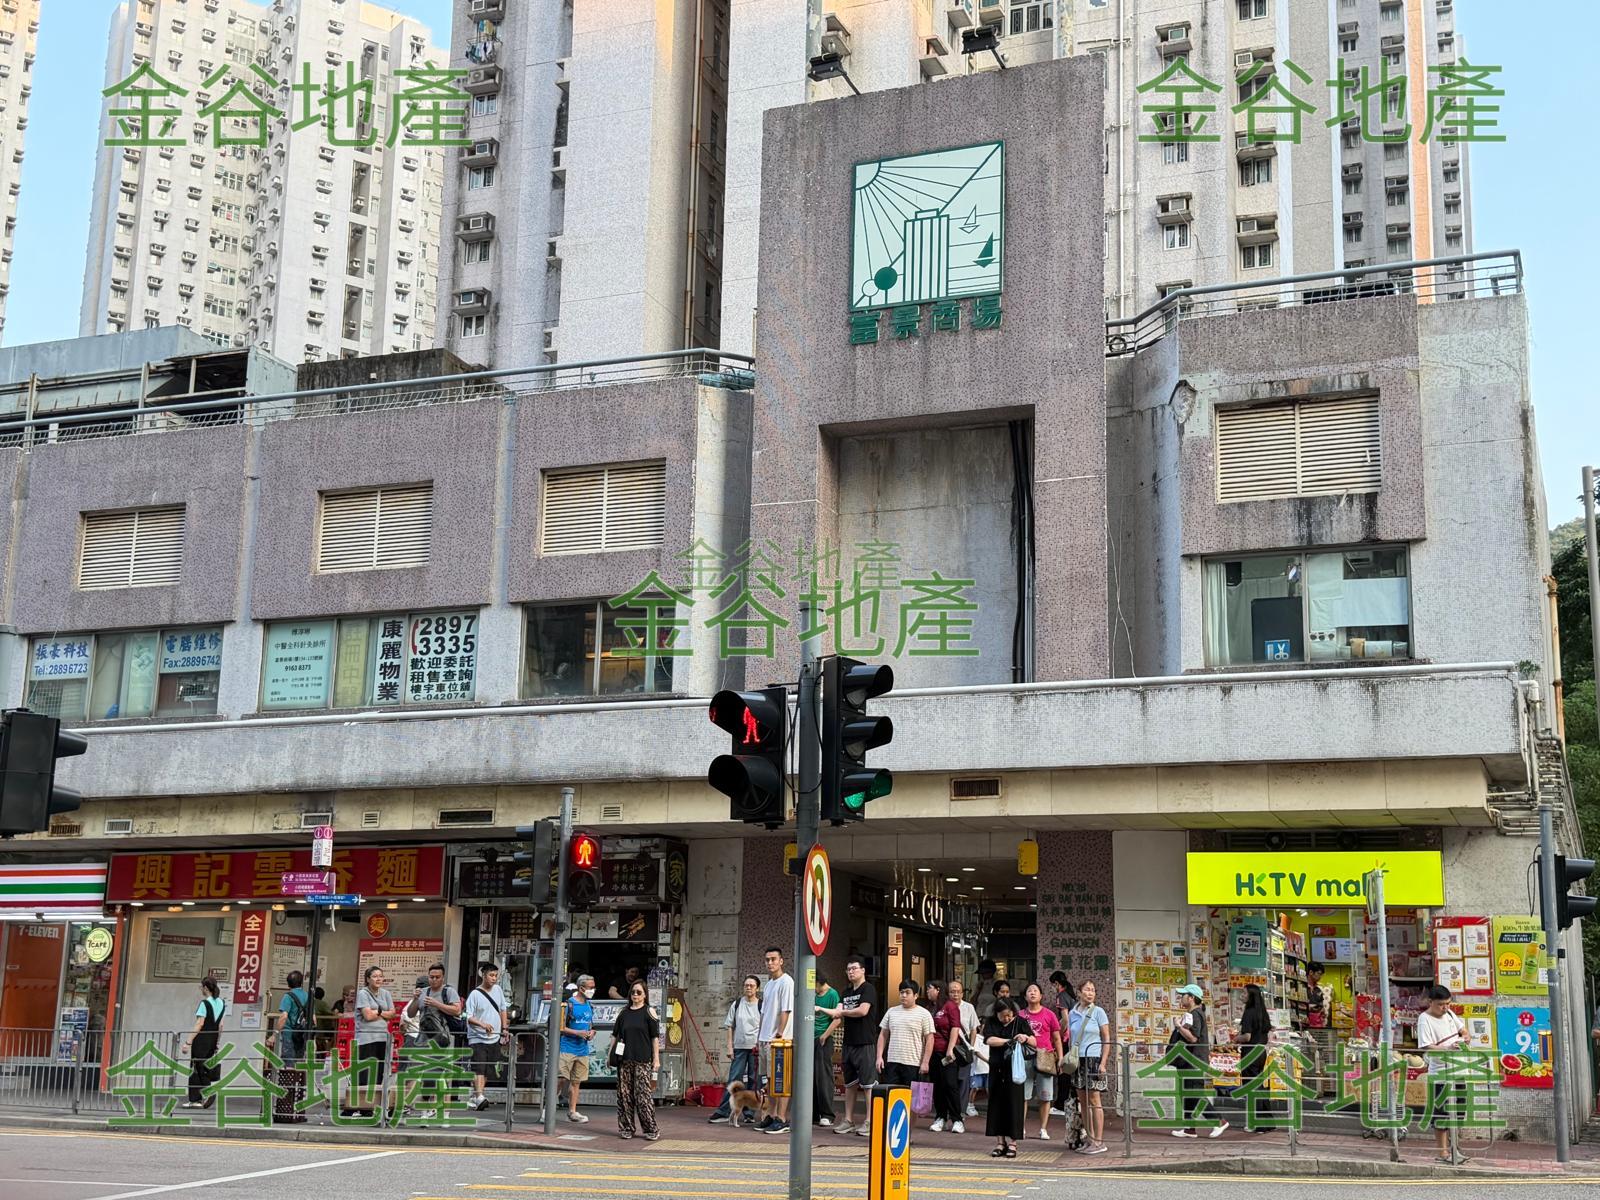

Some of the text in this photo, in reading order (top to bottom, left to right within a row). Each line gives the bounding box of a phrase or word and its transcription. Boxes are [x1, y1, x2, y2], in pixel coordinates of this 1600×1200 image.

[420, 615, 477, 636] 2897
[165, 632, 222, 653] 電腦維修
[418, 634, 475, 656] 3335
[377, 620, 403, 701] 康麗物業
[410, 655, 474, 670] 歡迎委託
[410, 669, 473, 684] 租售查詢
[413, 692, 466, 701] C-042074
[1235, 872, 1369, 896] HKTV mal
[238, 914, 262, 994] 全日29蚊
